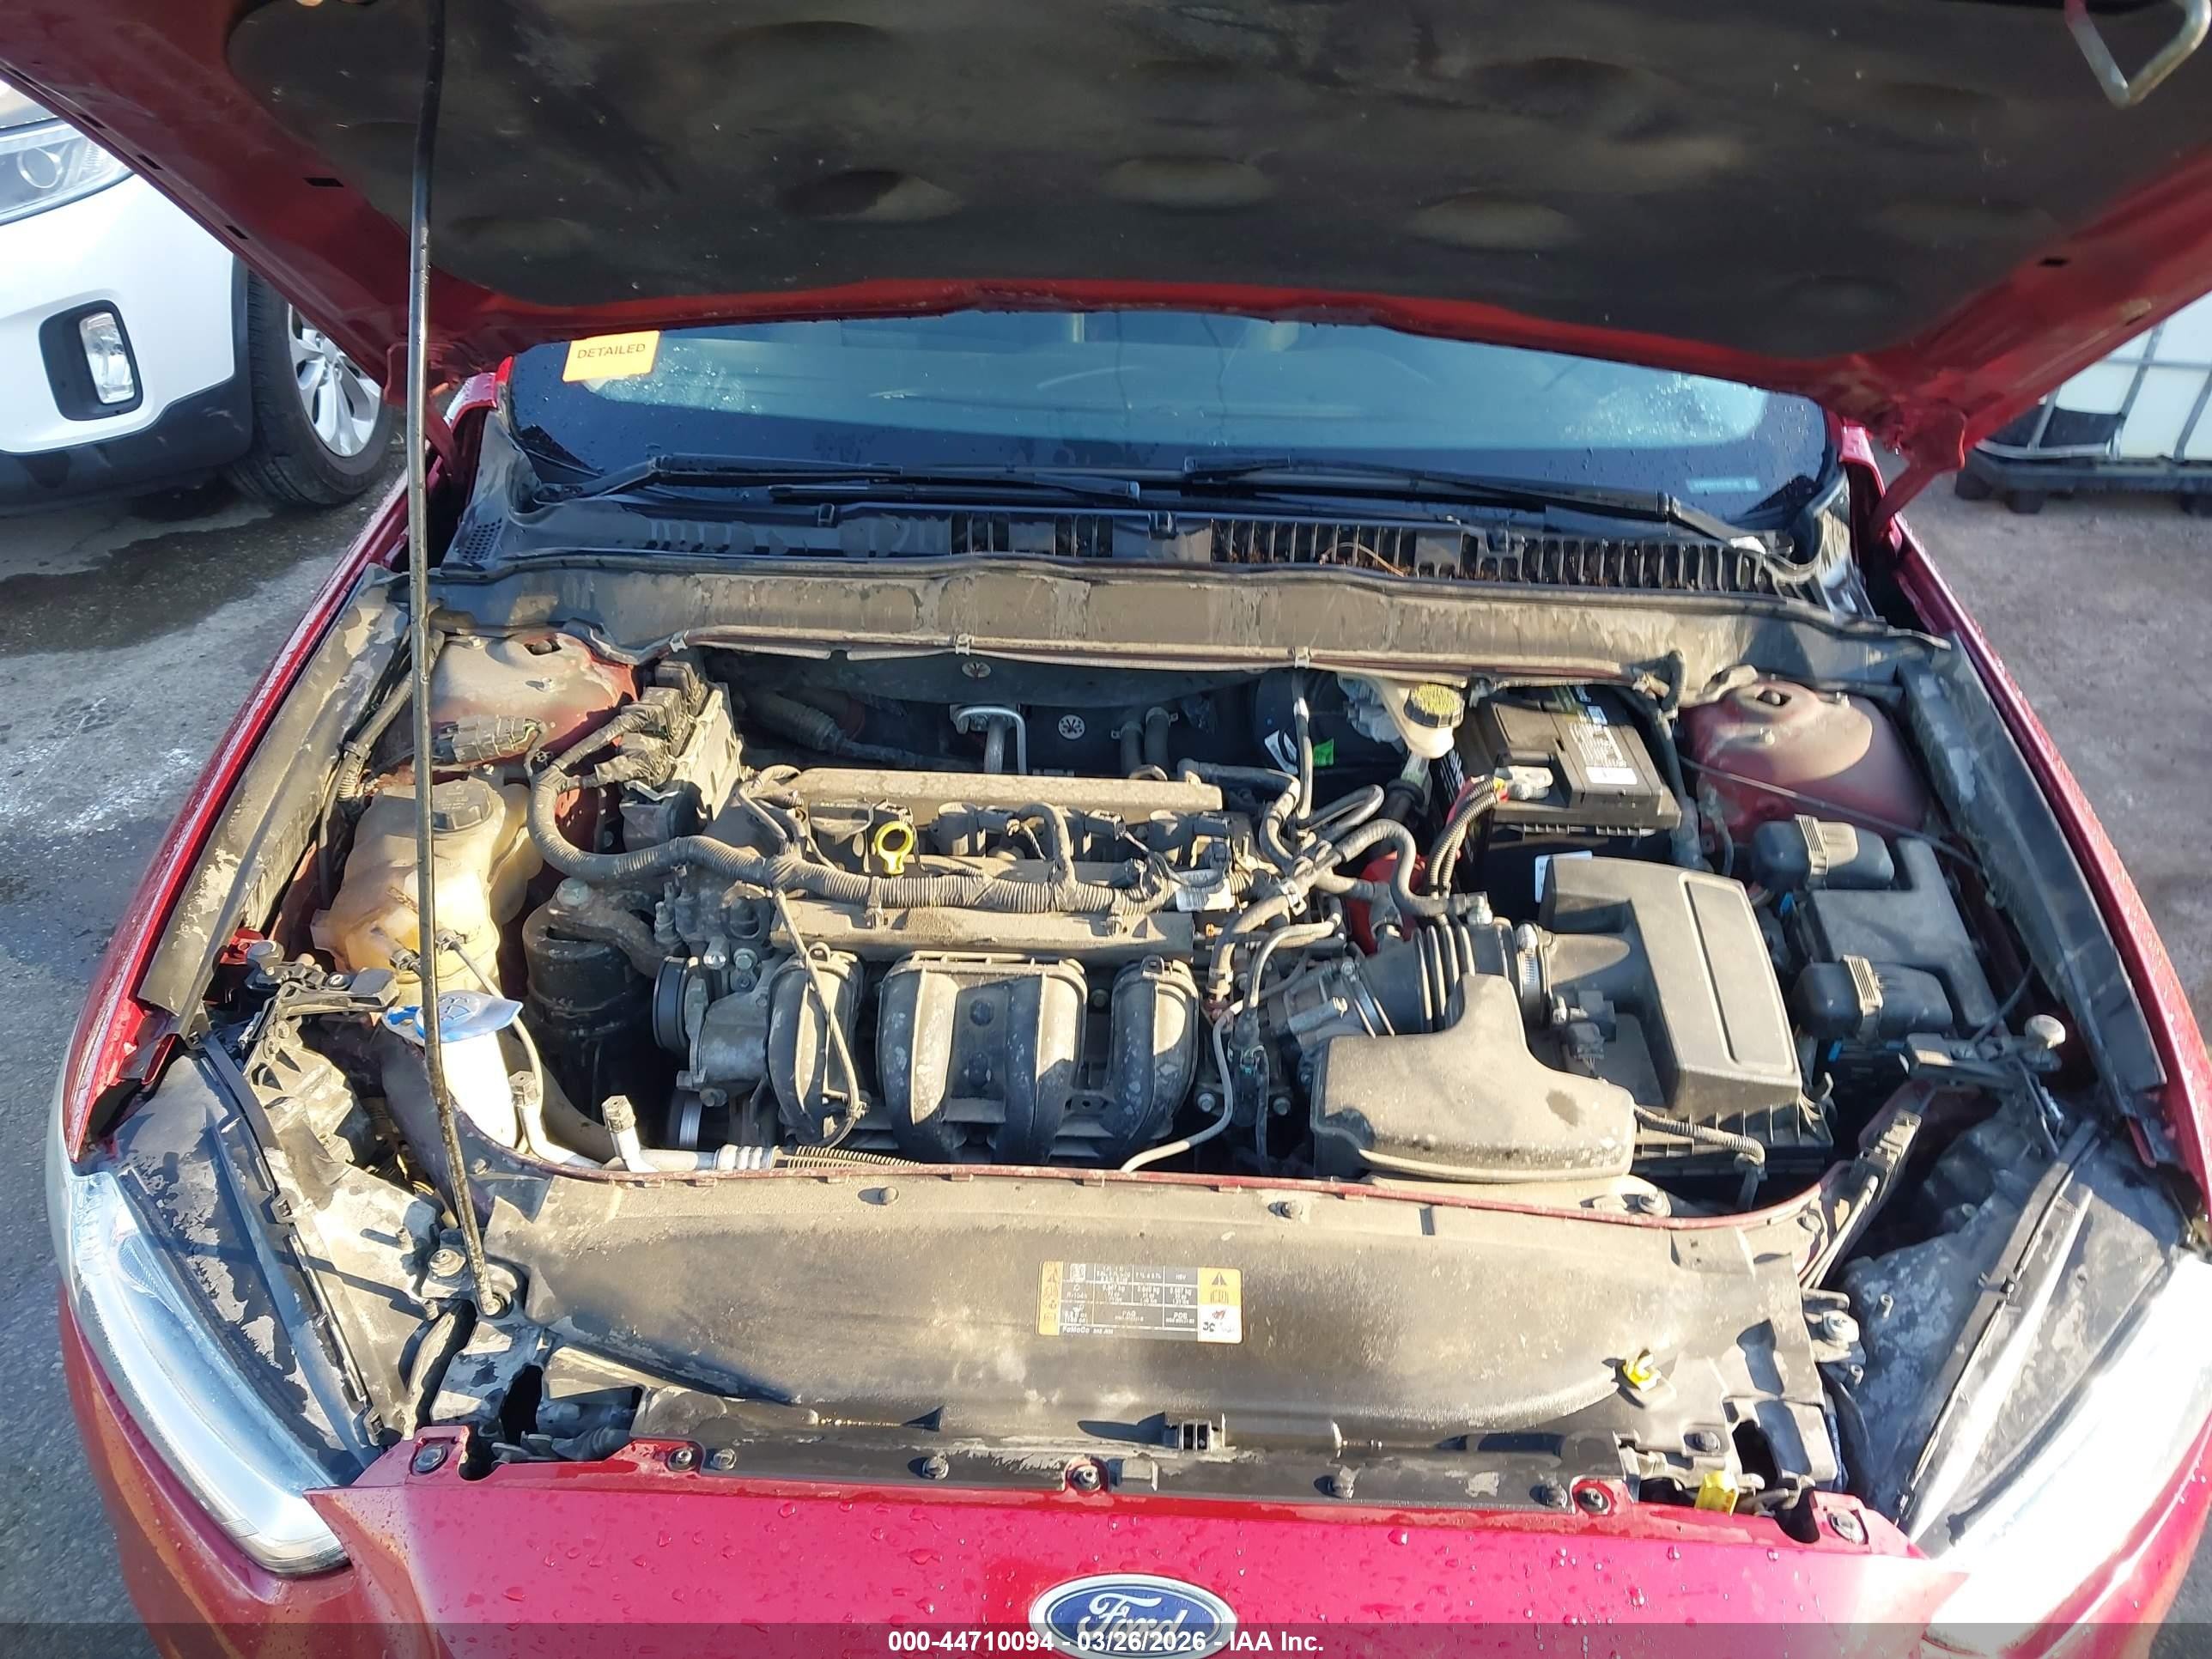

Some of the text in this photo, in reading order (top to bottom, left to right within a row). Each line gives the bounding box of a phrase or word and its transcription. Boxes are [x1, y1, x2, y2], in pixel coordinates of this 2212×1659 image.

[577, 343, 646, 359] DETAILED
[1062, 1325, 1090, 1334] FoMoCo
[1077, 1591, 1188, 1644] Ford
